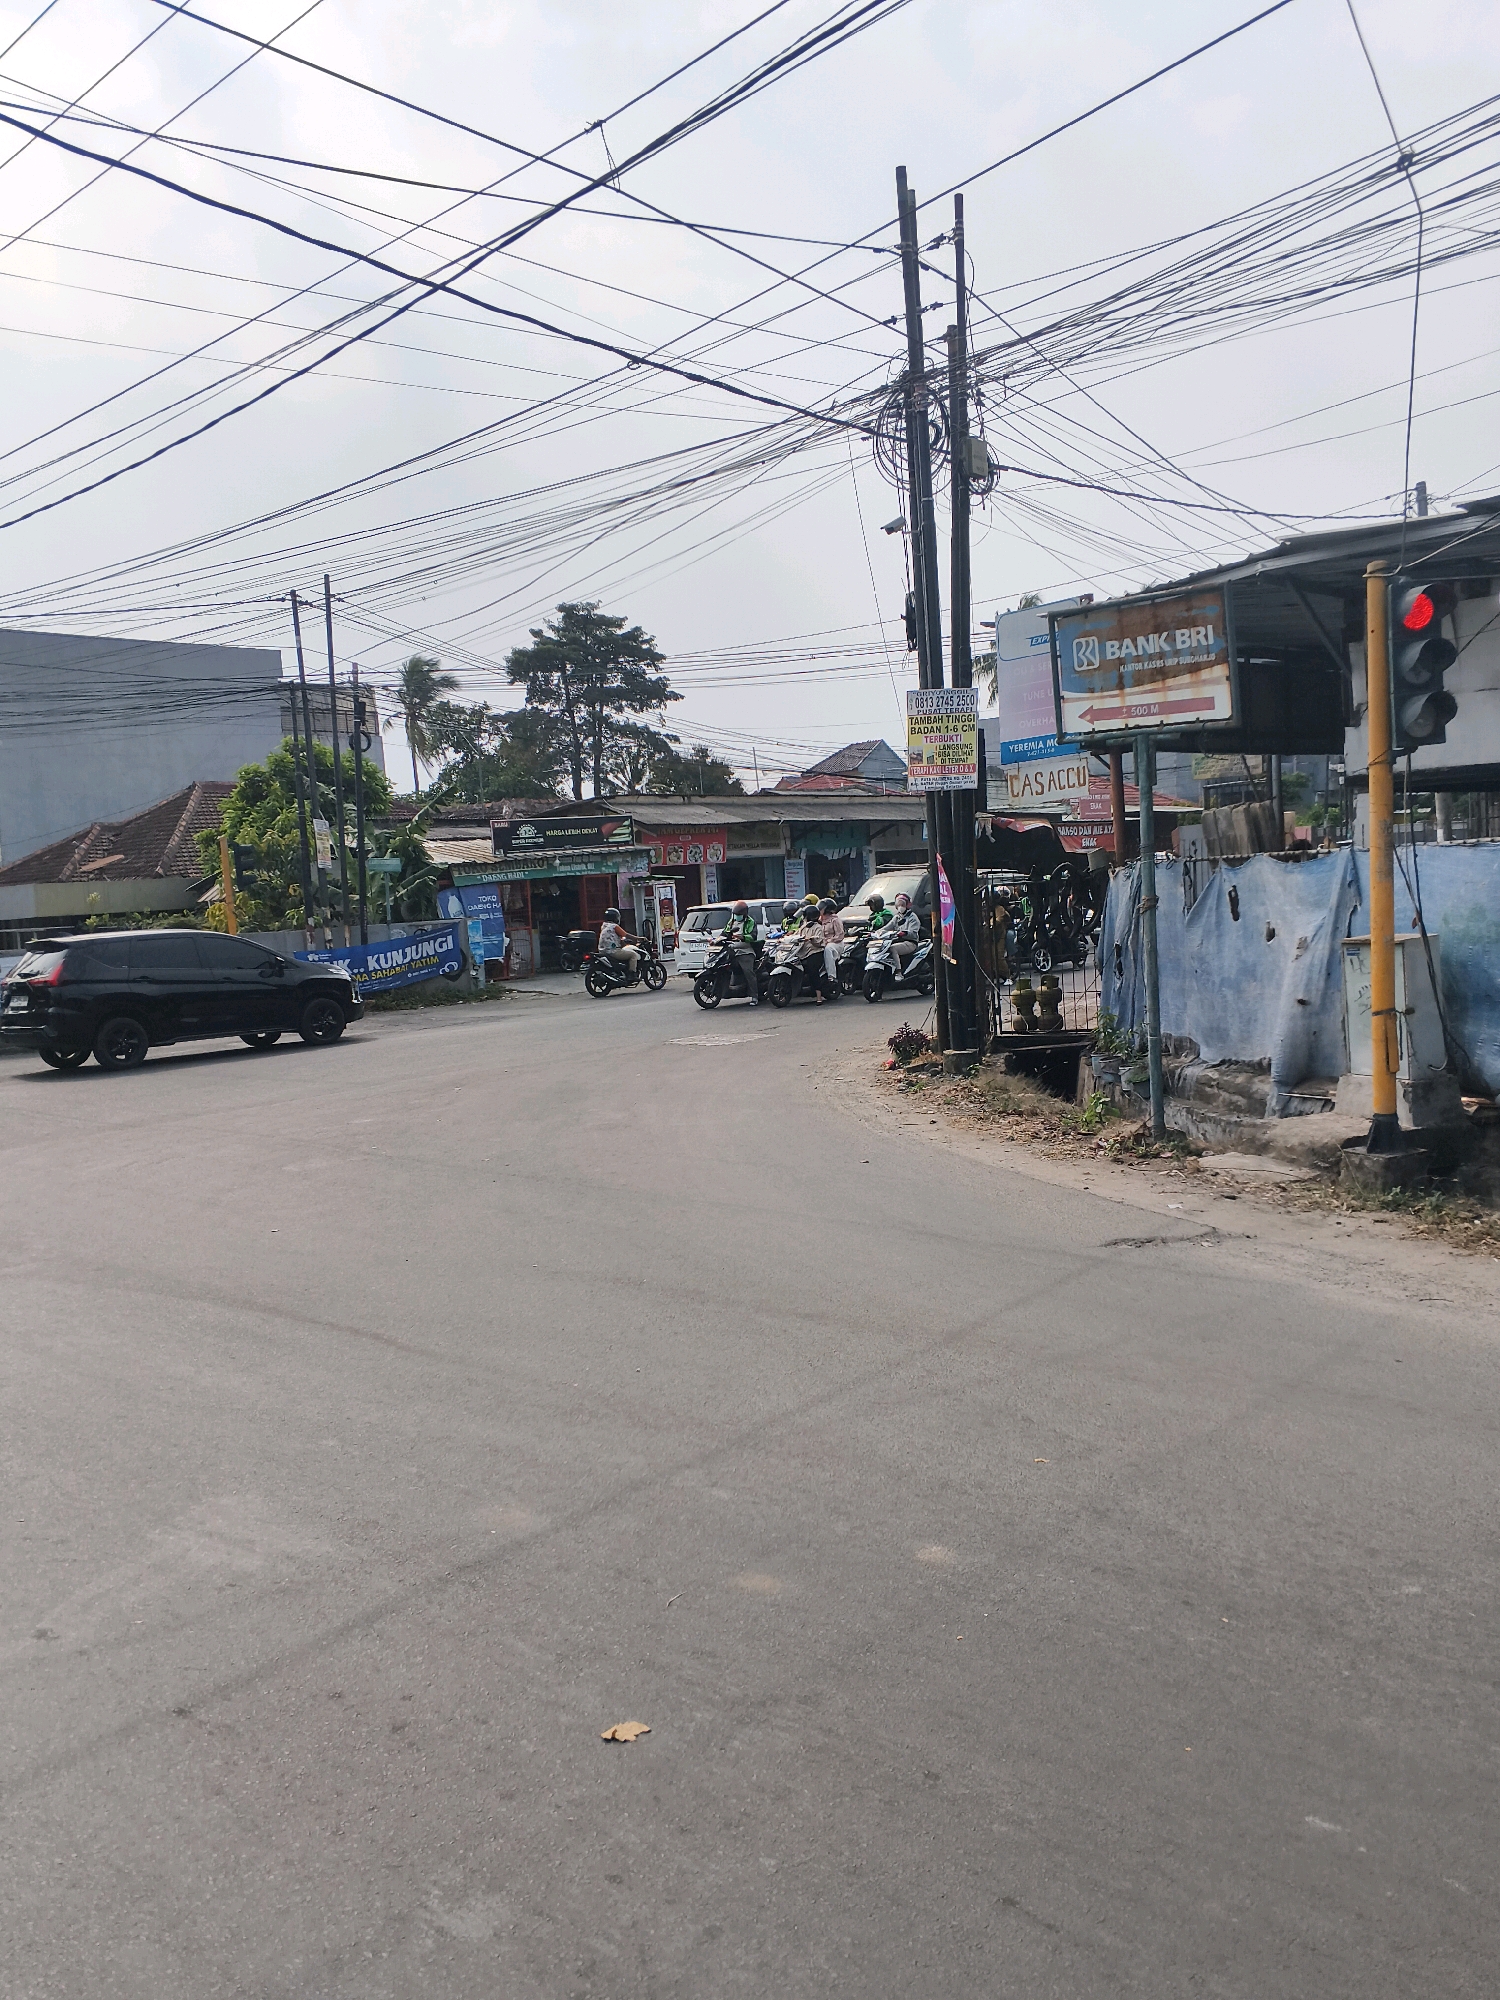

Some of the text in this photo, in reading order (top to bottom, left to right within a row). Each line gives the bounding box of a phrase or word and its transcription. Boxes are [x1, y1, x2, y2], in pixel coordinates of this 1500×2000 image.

[1105, 625, 1214, 660] BANK BRI
[1119, 663, 1143, 673] KANTOR
[1022, 690, 1045, 702] TUNE
[915, 697, 934, 709] 0813
[936, 696, 954, 707] 2745
[1131, 707, 1148, 716] 500
[1150, 704, 1159, 714] M
[909, 714, 976, 725] TAMBAH TINGGI
[1018, 716, 1055, 728] OVERHA
[910, 724, 976, 735] BADAN 1-6 CM
[924, 734, 962, 743] TERBUKTI
[938, 743, 973, 751] LANGSUNG
[1008, 740, 1045, 753] YEREMIA
[938, 750, 951, 758] BISA
[910, 766, 929, 775] TERAPI
[942, 765, 959, 774] LETER
[969, 764, 974, 772] X
[1009, 765, 1087, 798] CAS ACCU
[1079, 826, 1092, 836] DAN
[1093, 826, 1103, 835] MIE
[1104, 825, 1115, 834] AYA
[1081, 837, 1097, 847] ENAK
[468, 902, 491, 911] DAENG
[366, 935, 454, 972] KUNJUNGI
[371, 963, 409, 980] SAHABAT
[410, 955, 440, 969] YATIM
